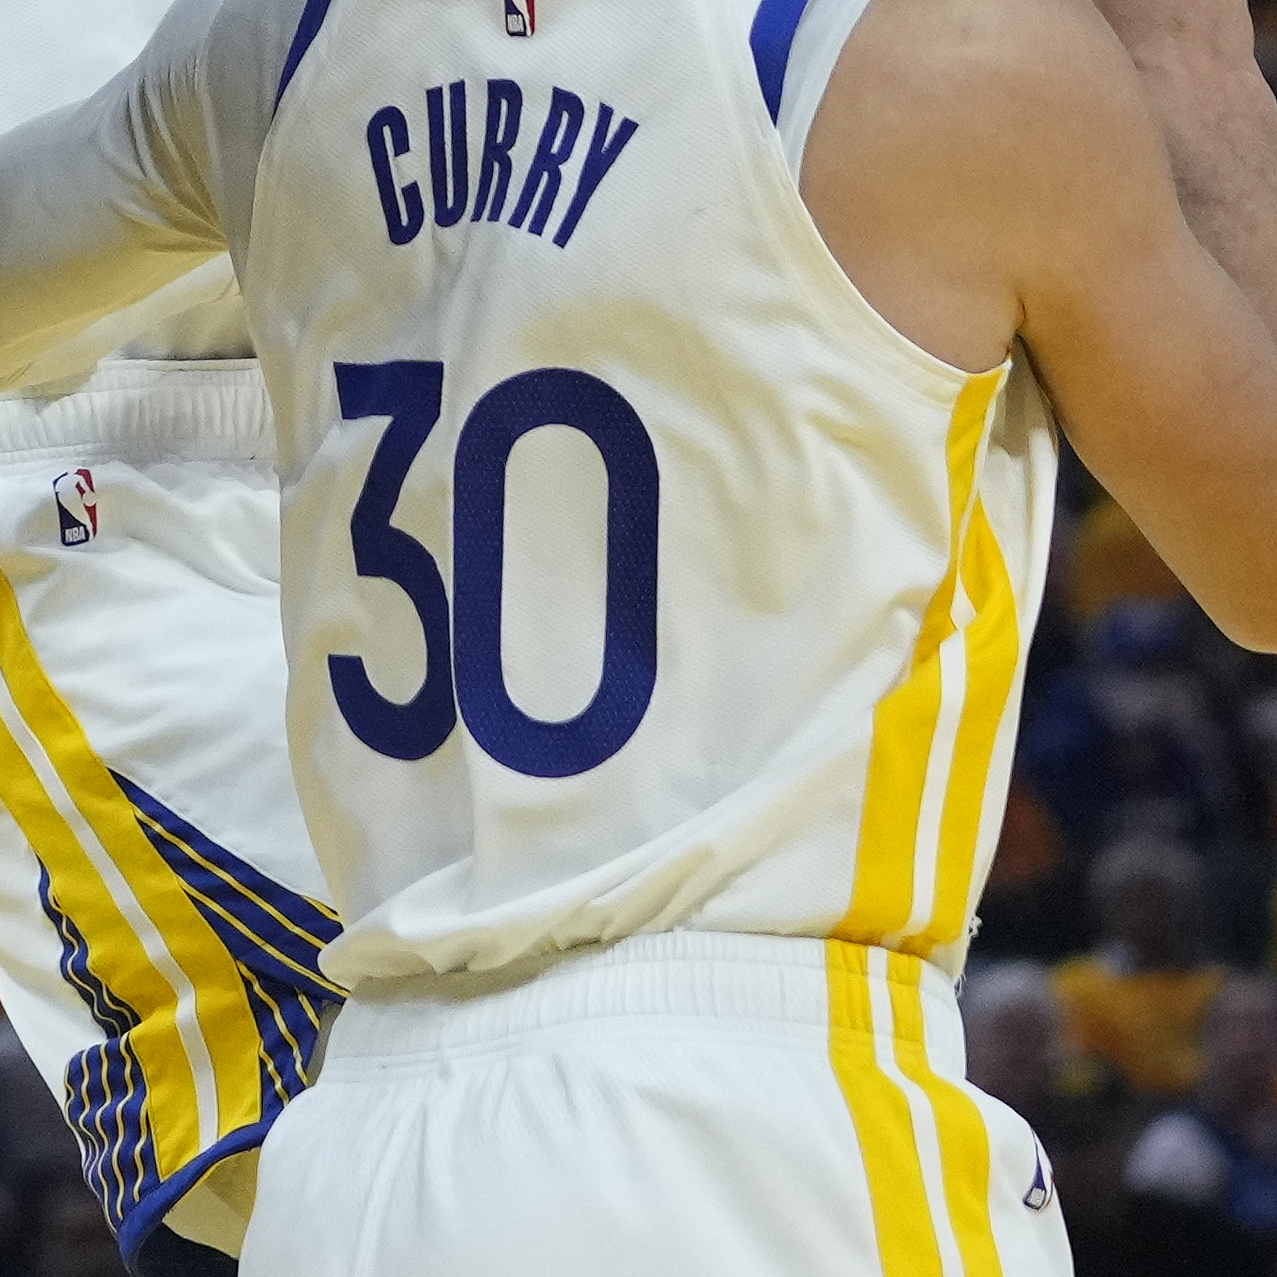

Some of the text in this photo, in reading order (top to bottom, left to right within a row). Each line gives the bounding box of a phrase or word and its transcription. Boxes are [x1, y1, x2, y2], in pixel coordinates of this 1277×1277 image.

[366, 78, 640, 249] CURRY
[65, 525, 86, 543] NBA
[327, 358, 660, 778] 30
